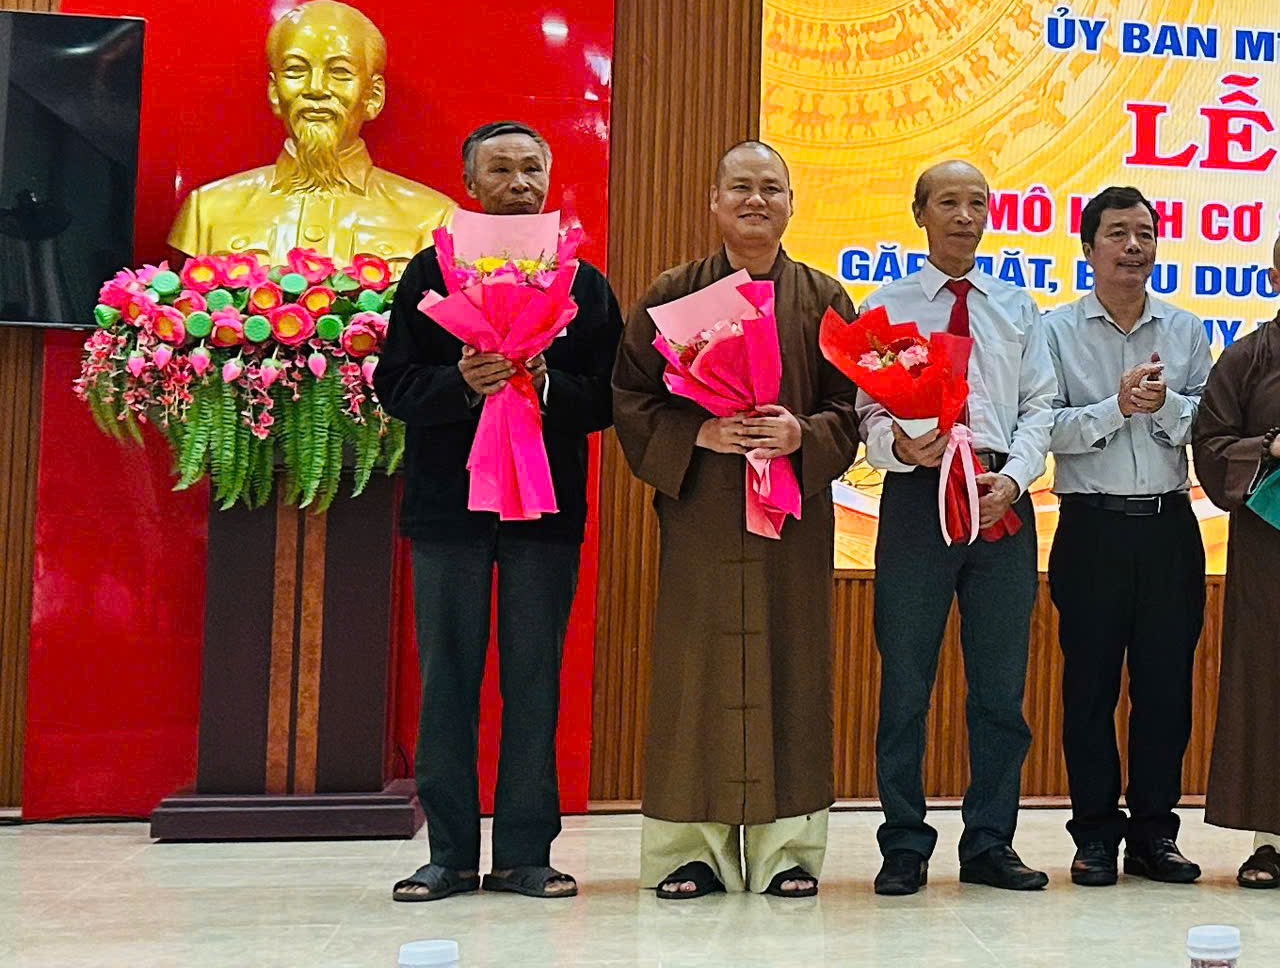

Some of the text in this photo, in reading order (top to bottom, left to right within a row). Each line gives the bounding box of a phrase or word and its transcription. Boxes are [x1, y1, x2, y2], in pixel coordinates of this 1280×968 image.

[1047, 7, 1106, 52] ỦY
[1122, 22, 1217, 59] BAN
[1125, 73, 1278, 172] LỄ
[986, 186, 1053, 233] MÔ
[1201, 202, 1263, 243] CƠ
[1076, 260, 1178, 294] BU
